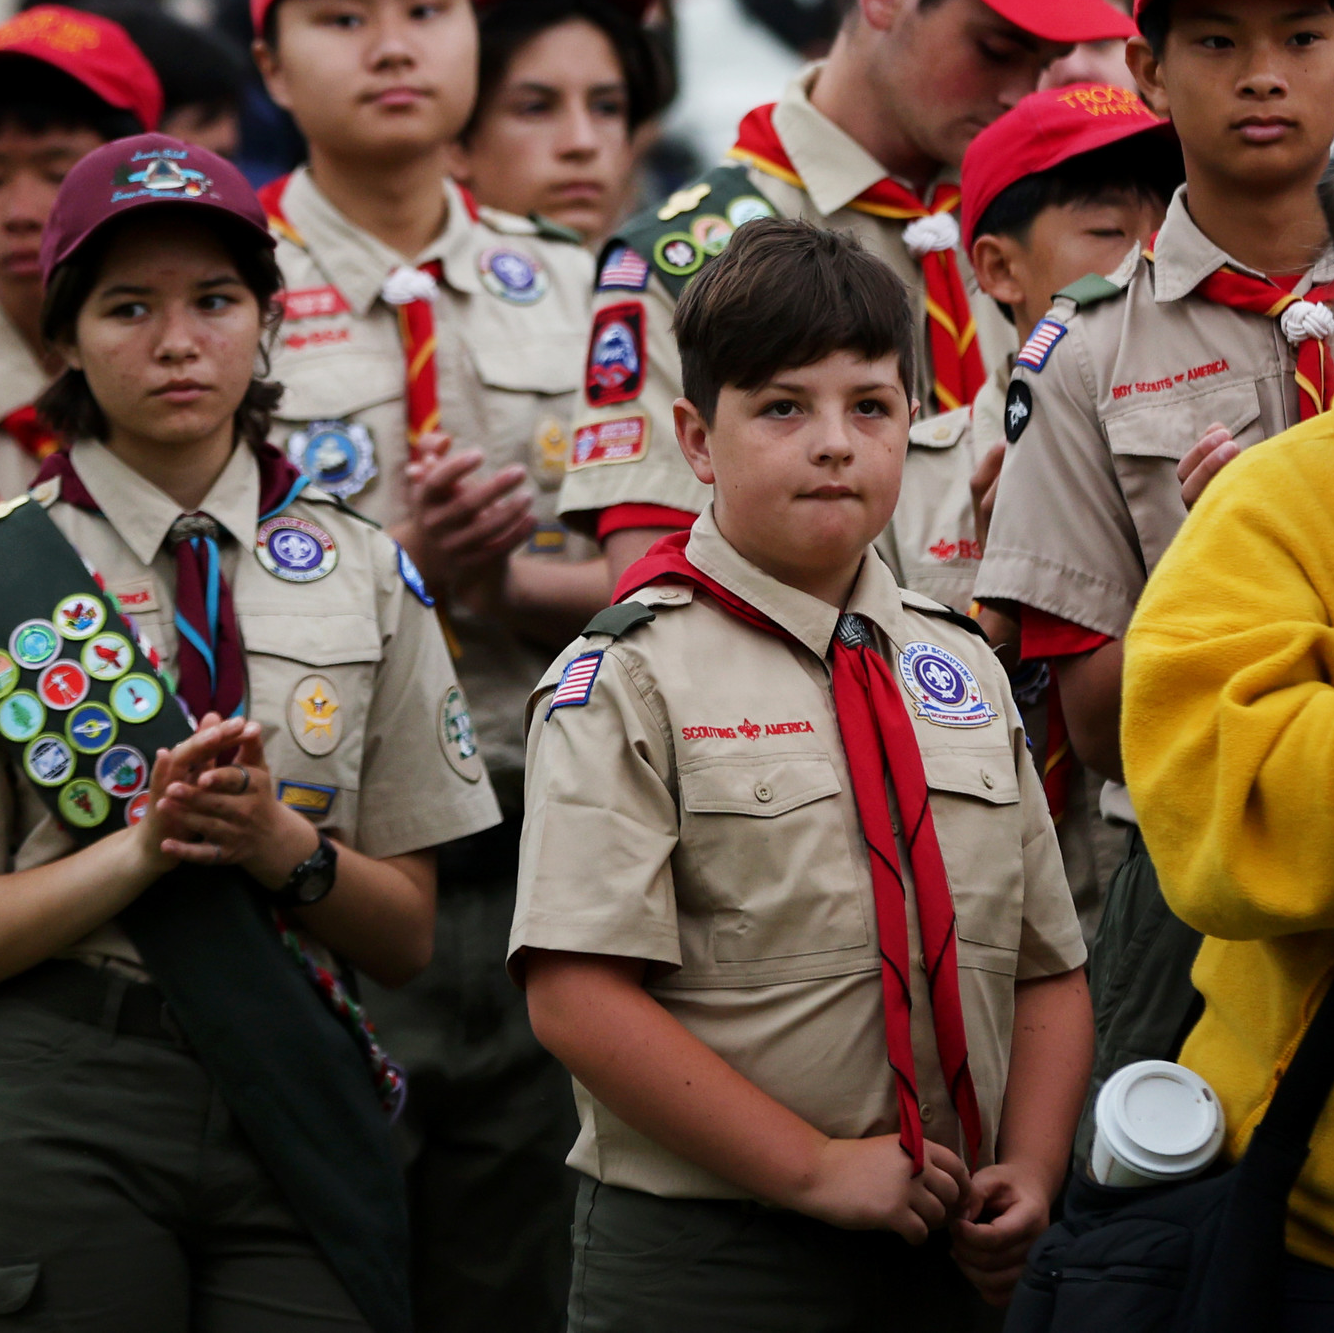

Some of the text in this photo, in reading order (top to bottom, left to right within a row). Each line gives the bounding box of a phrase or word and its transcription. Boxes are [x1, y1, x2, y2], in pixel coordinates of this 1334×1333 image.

[1056, 85, 1138, 109] TROOP
[1112, 383, 1132, 400] BOY
[1135, 376, 1173, 393] SCOUTS
[1187, 357, 1230, 382] AMERICA
[959, 538, 983, 560] BS
[902, 645, 918, 666] YEARS
[931, 646, 974, 683] SCOUTING
[681, 720, 815, 741] SCOUTING AMERICA
